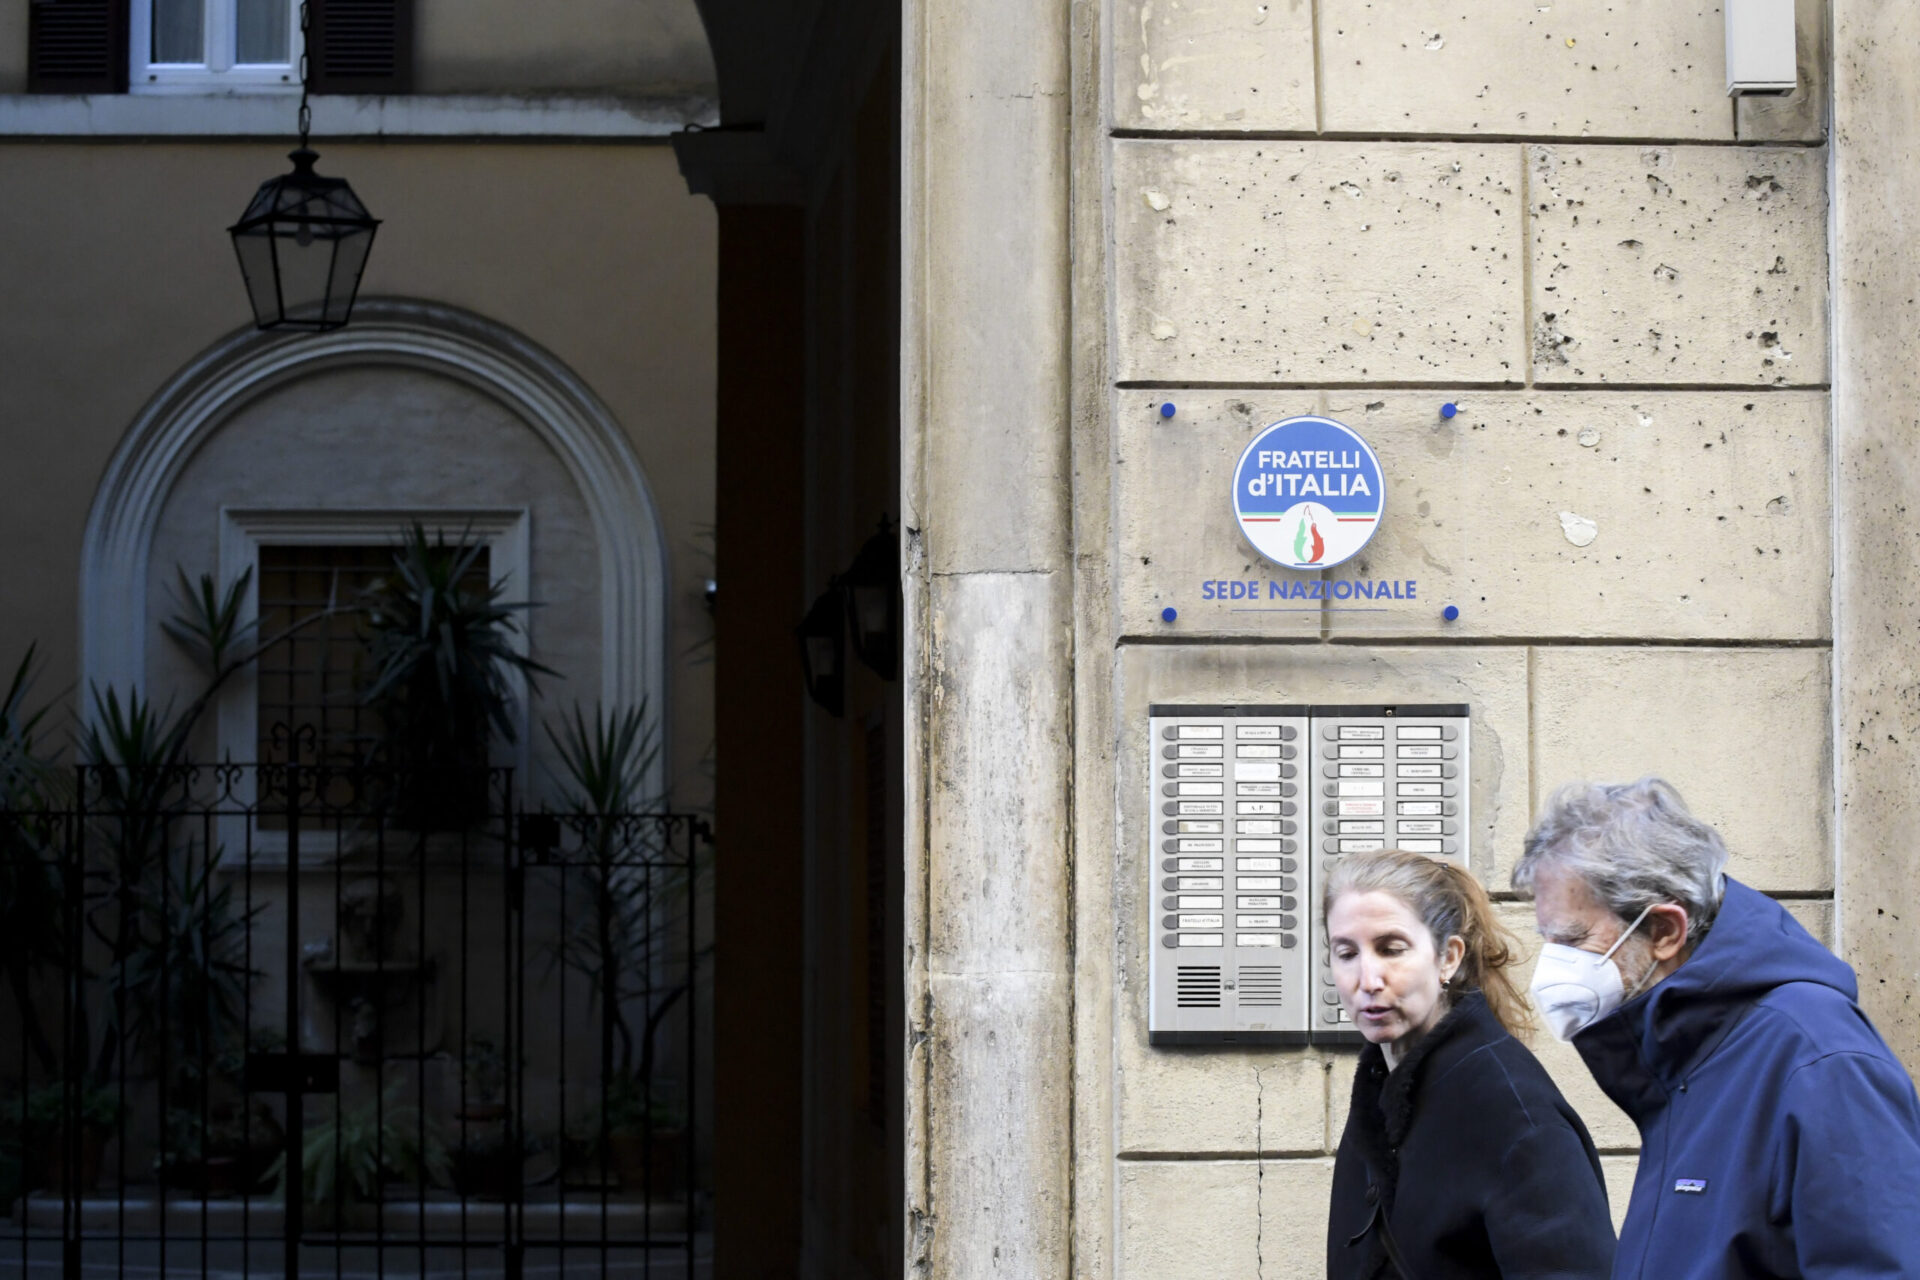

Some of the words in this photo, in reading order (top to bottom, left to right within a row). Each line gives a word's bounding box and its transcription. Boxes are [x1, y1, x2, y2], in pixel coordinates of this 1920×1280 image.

[1258, 450, 1360, 469] FRATELLI
[1248, 473, 1371, 497] d'ITALIA
[1201, 580, 1259, 600] SEDE
[1269, 580, 1417, 600] NAZIONALE
